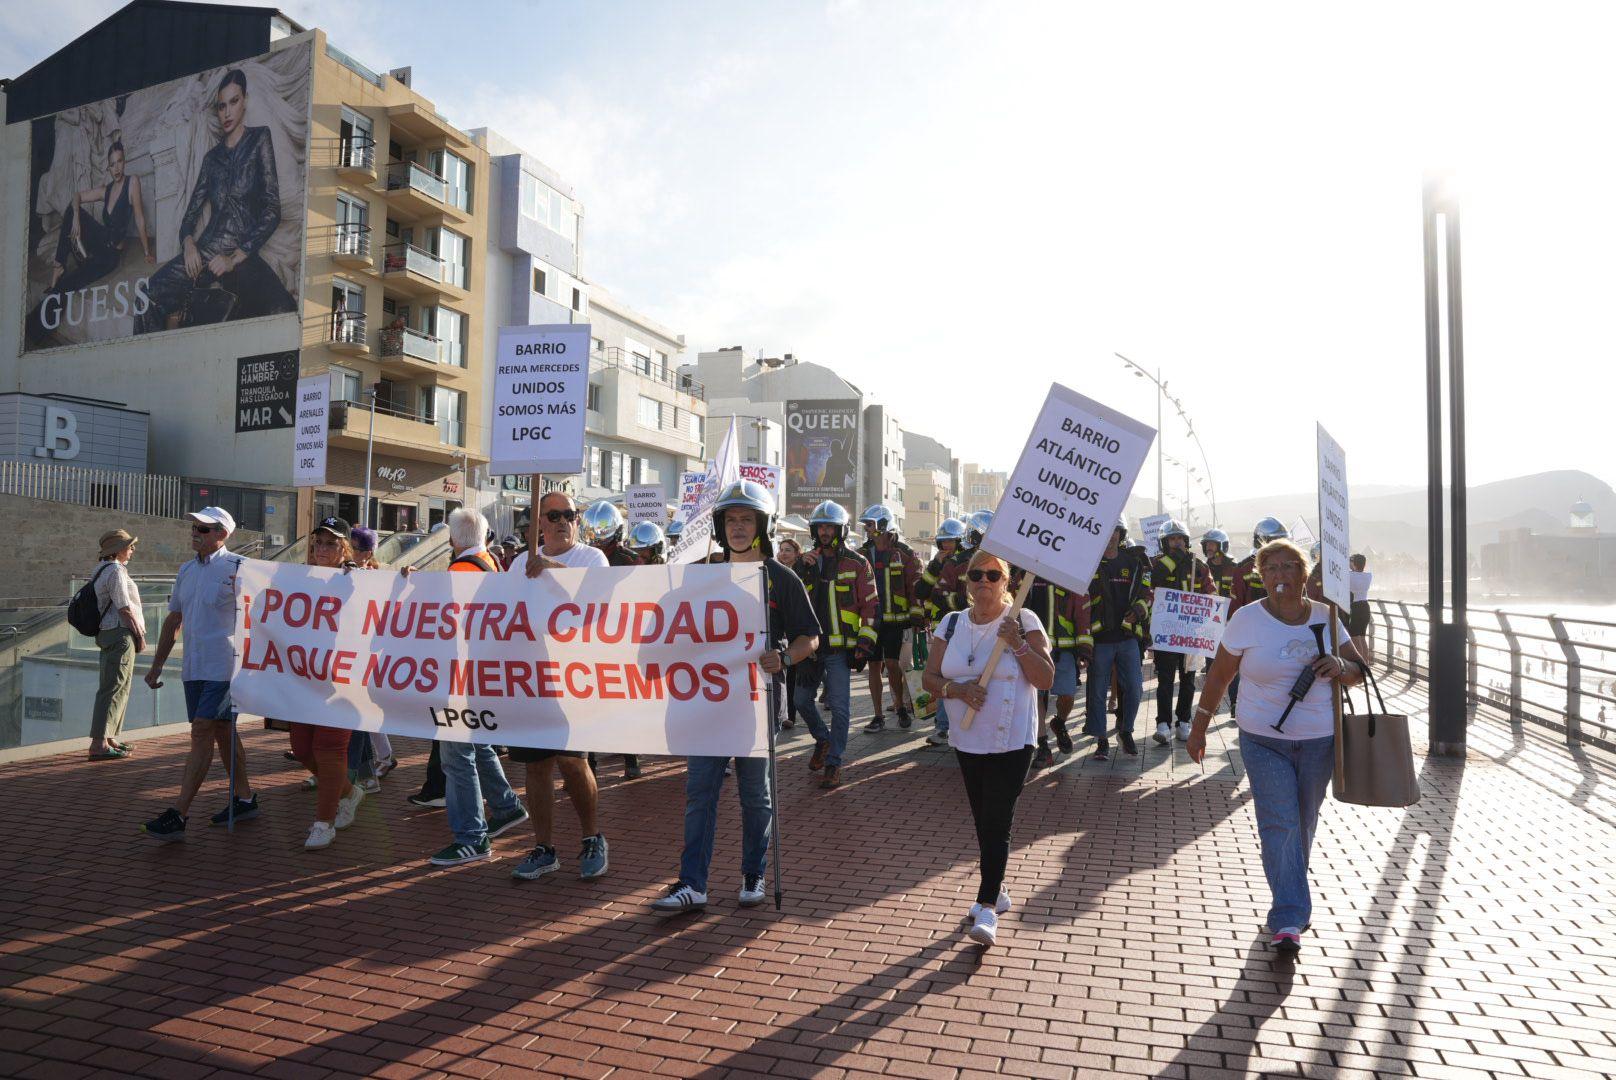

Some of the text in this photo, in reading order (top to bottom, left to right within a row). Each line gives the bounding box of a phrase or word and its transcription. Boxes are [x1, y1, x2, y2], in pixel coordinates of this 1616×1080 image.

[40, 276, 150, 330] GUESS
[515, 343, 566, 356] BARRIO
[241, 361, 275, 375] ¿TIENES
[499, 364, 580, 374] REINA MERCEDES
[241, 370, 279, 385] HAMBRE?
[241, 385, 276, 396] TRANQUILA
[512, 381, 565, 394] UNIDOS
[240, 391, 290, 404] HAS LLEGADO A
[303, 391, 322, 403] BARRIO
[299, 407, 324, 418] ARENALES
[498, 401, 576, 416] SOMOS MÁS
[240, 406, 272, 427] MAR
[787, 412, 857, 434] QUEEN
[301, 424, 321, 435] UNIDOS
[512, 426, 552, 441] LPGC
[1061, 417, 1120, 454] BARRIO
[296, 442, 313, 451] SOMOS
[300, 457, 315, 469] LPGC
[1036, 437, 1122, 486] ATLÁNTICO
[1324, 455, 1341, 482] BARRIO
[377, 466, 407, 481] MAR
[738, 465, 768, 480] BEROS
[1038, 467, 1100, 506] UNIDOS
[1321, 477, 1346, 510] ATLÁNTICO
[1012, 486, 1103, 536] SOMOS MÁS
[1325, 506, 1344, 532] UNIDOS
[1016, 518, 1066, 552] LPGC
[1322, 528, 1339, 552] SOMOS
[1328, 558, 1342, 582] LPGC
[1165, 591, 1180, 602] EN
[1167, 603, 1211, 617] LA ISLETA
[260, 588, 342, 632] POR
[361, 599, 536, 641] NUESTRA
[547, 600, 755, 650] CIUDAD,
[1155, 633, 1215, 651] QUE BOMBEROS
[241, 637, 284, 673] LA
[286, 644, 357, 685] QUE
[361, 653, 439, 693] NOS
[448, 659, 730, 702] MERECEMOS
[429, 706, 498, 731] LPGC
